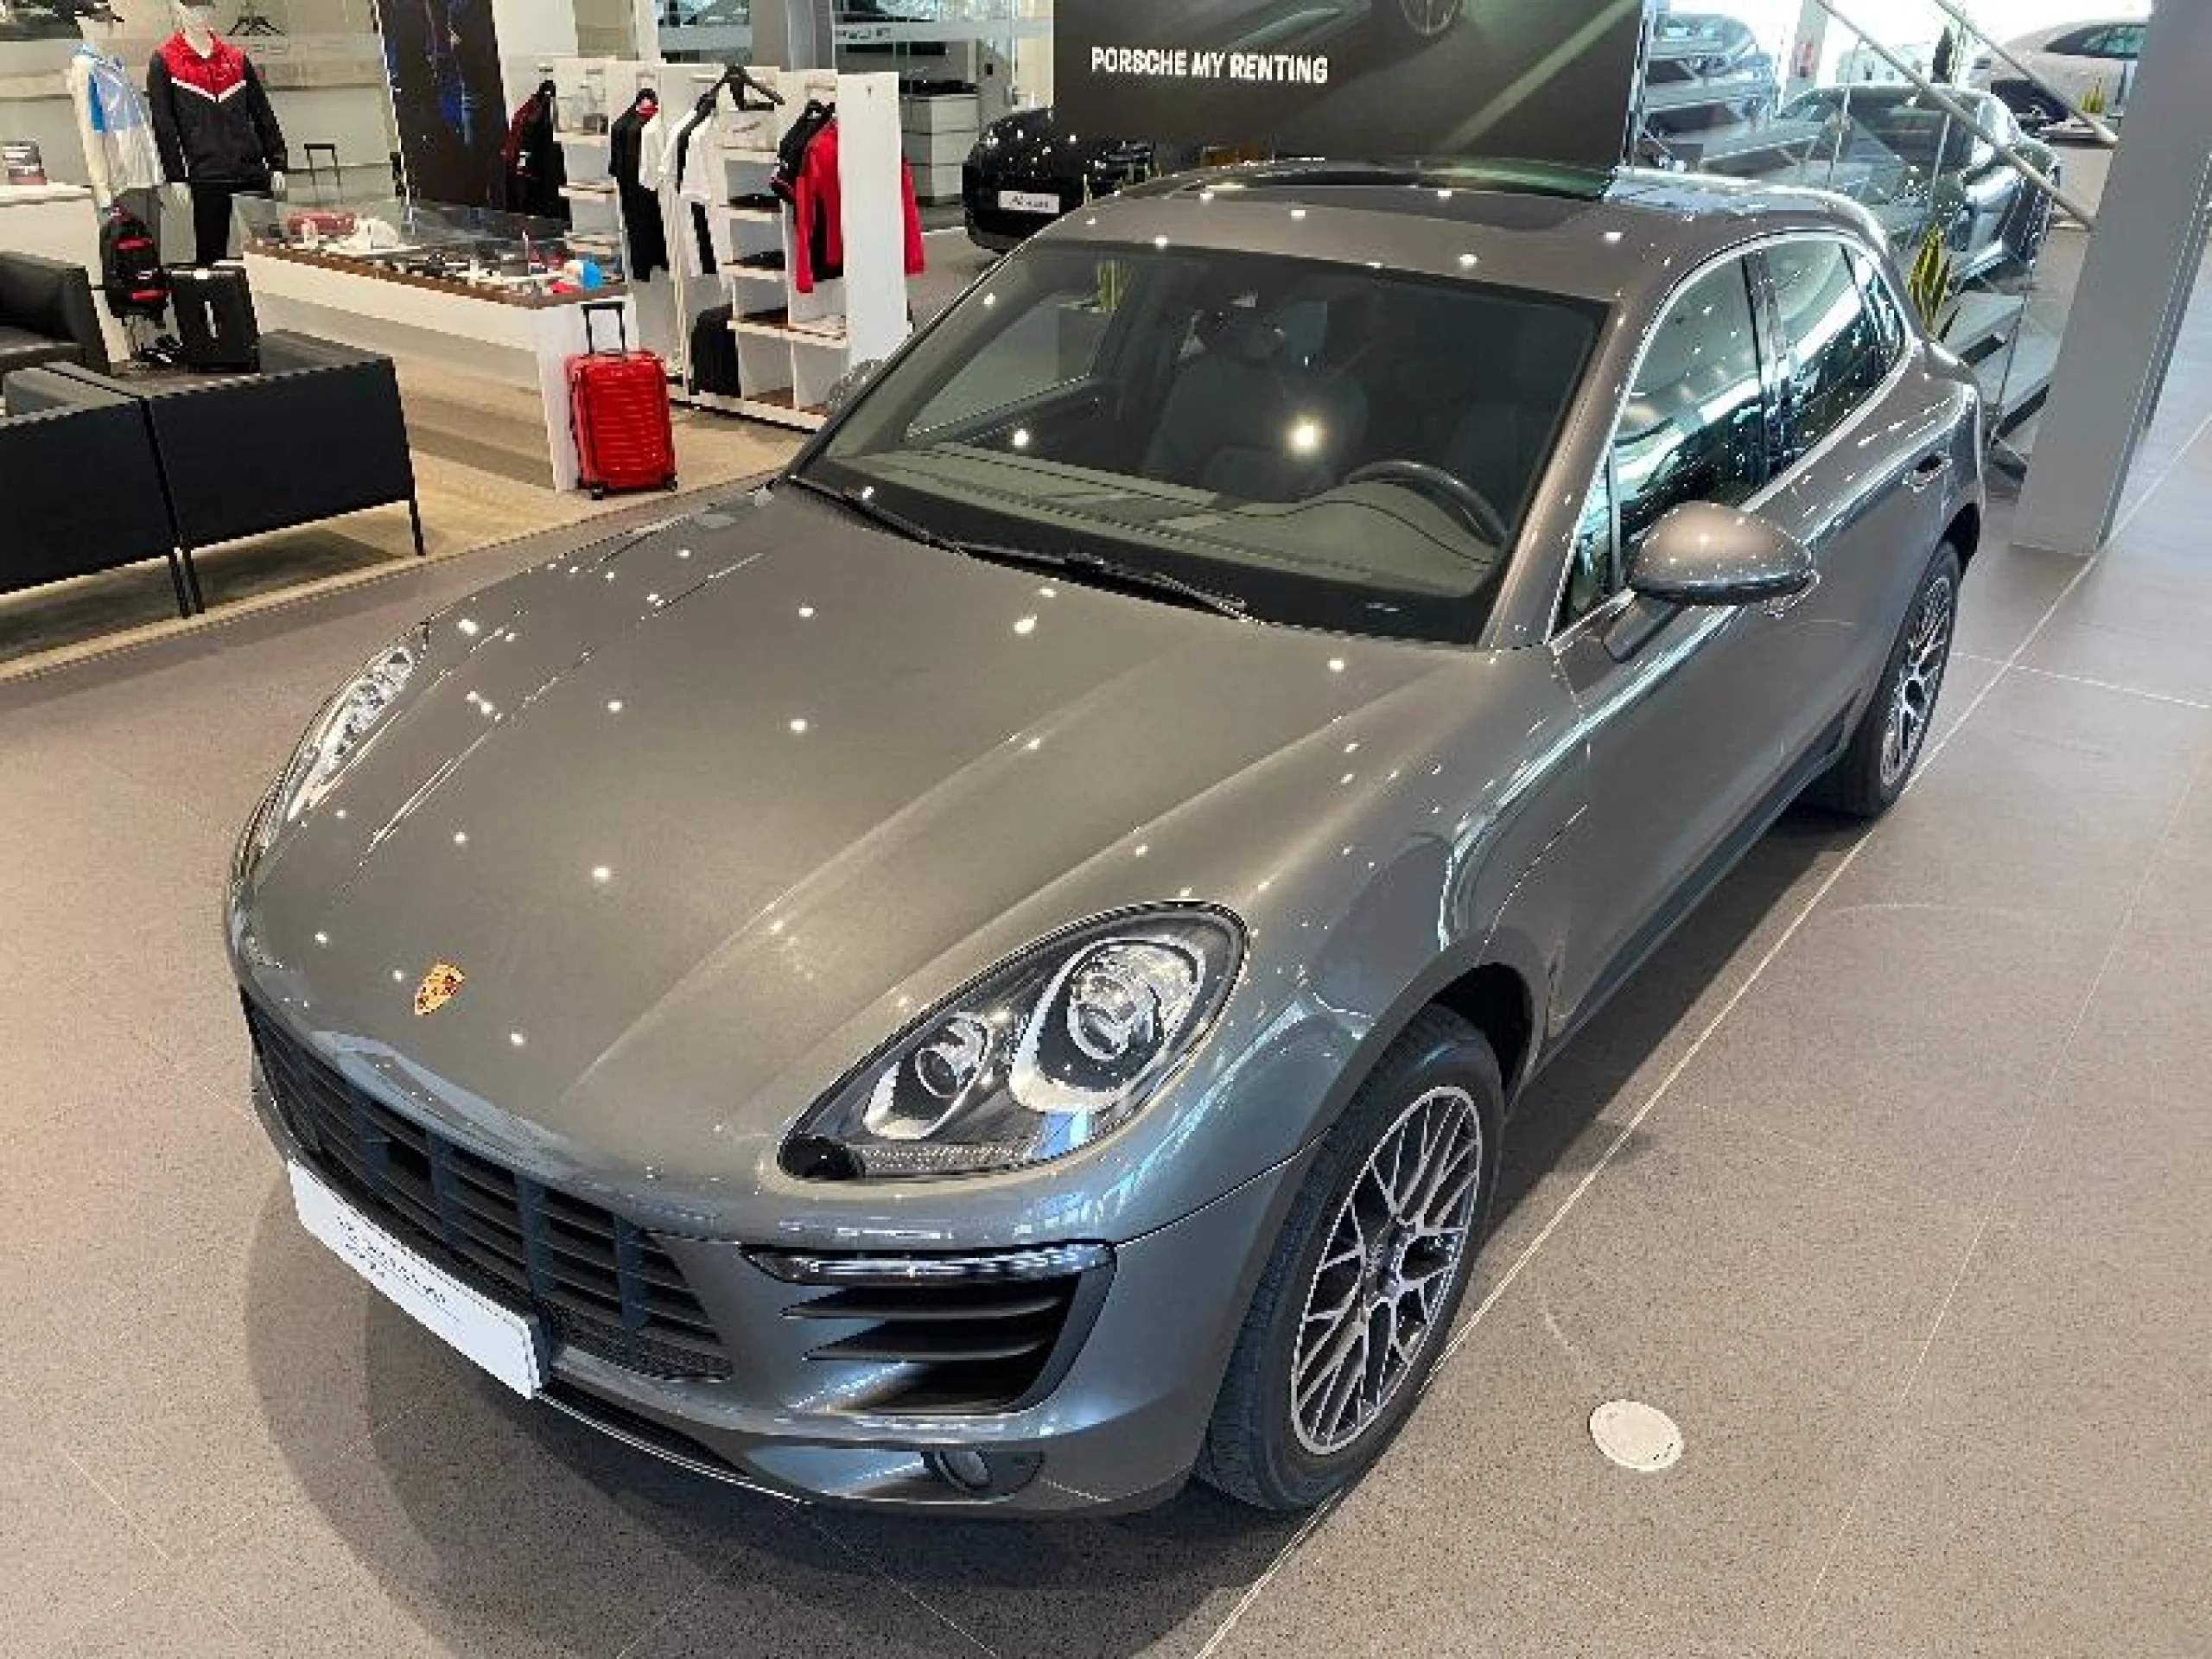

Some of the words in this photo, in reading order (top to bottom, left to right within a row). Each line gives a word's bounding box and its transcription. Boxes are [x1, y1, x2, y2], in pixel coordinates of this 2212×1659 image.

[1091, 47, 1187, 75] PORSCHE
[1192, 52, 1225, 78] MY
[1230, 54, 1328, 84] RENTING
